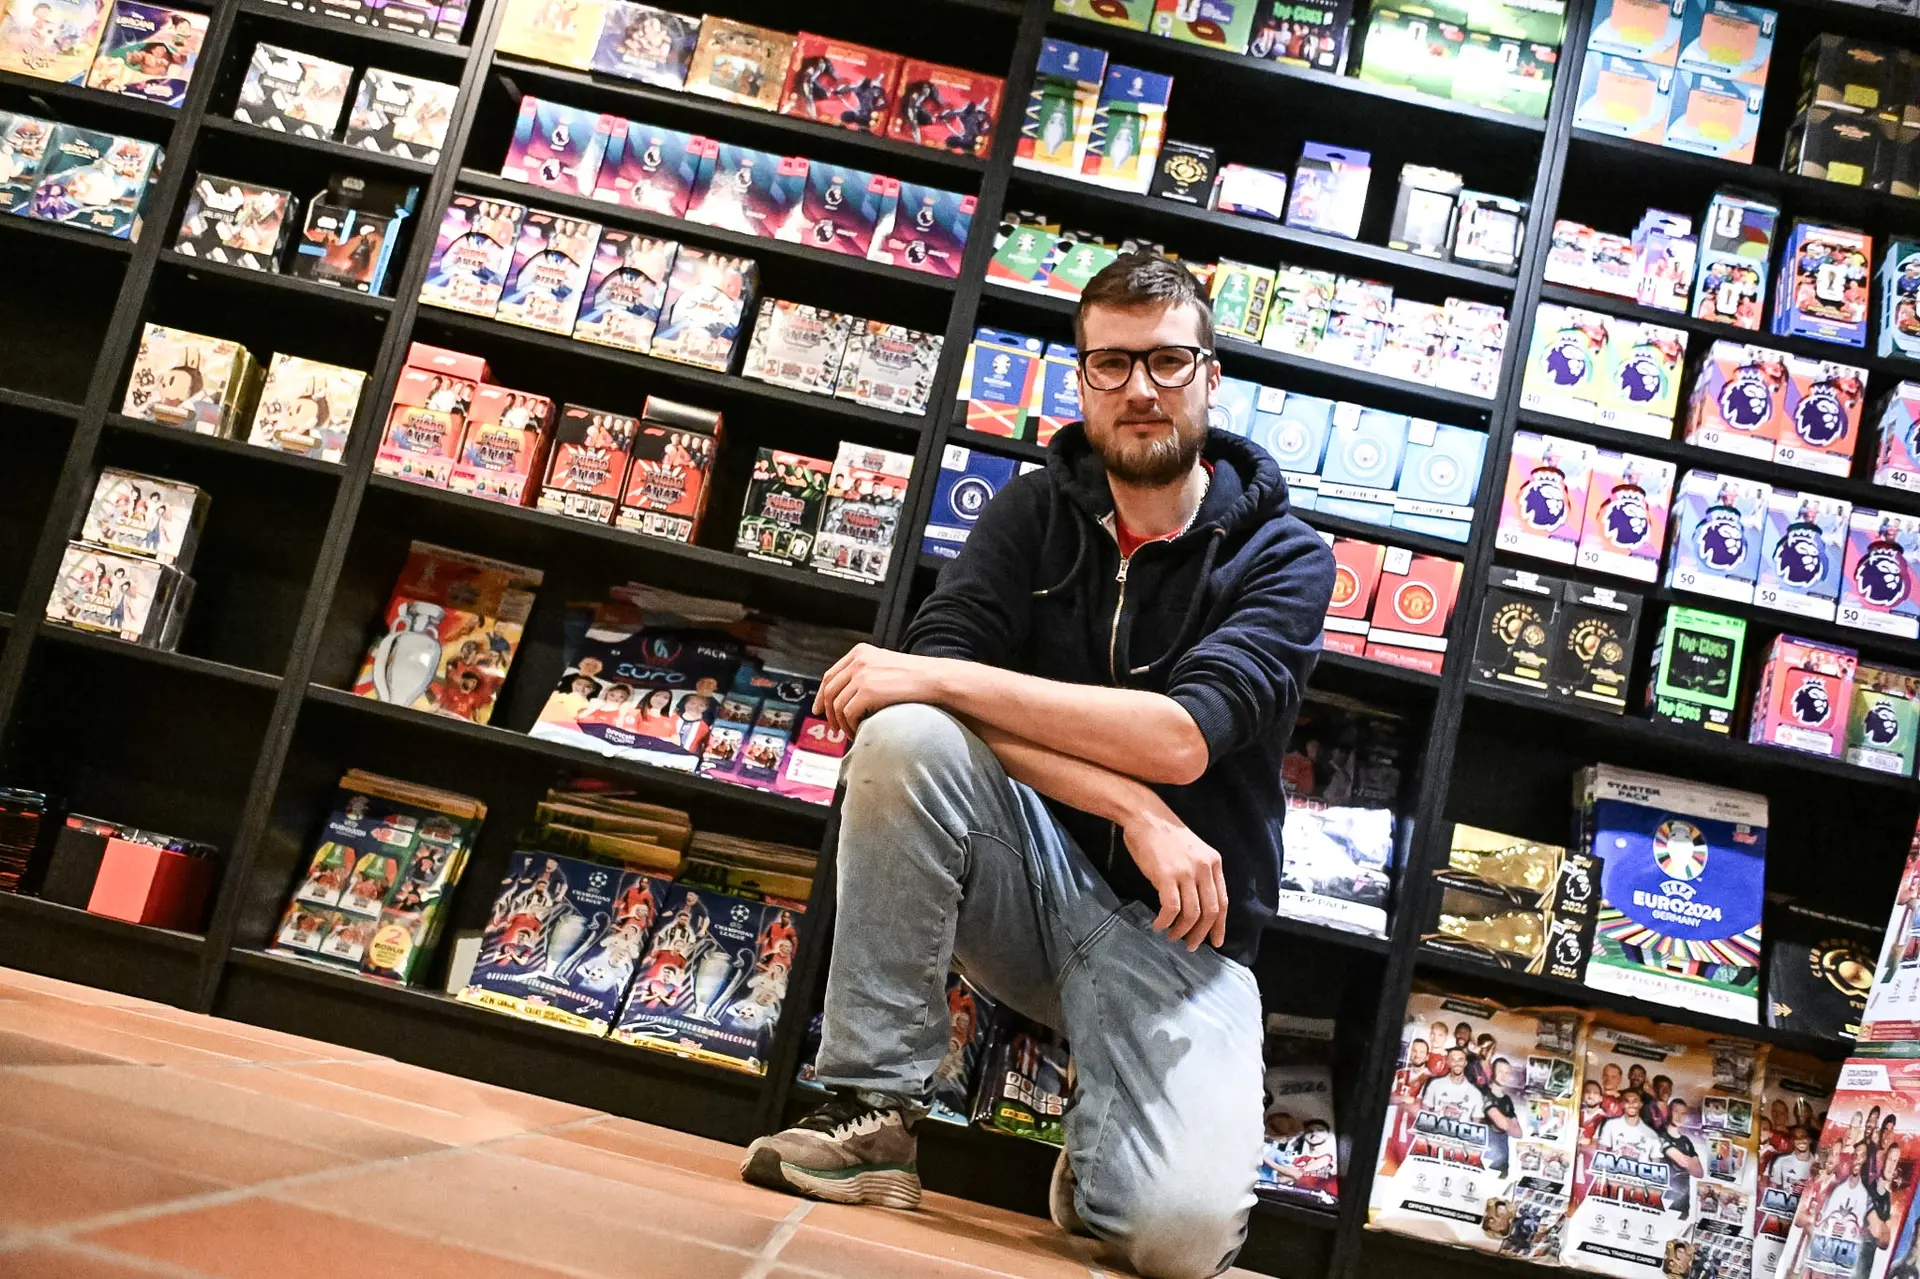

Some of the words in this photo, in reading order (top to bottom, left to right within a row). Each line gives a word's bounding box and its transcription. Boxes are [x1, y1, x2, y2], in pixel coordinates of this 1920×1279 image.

[1601, 410, 1616, 421] 40
[406, 427, 442, 445] ATTAX
[1704, 432, 1719, 443] 40
[480, 445, 516, 463] ATTAX
[1778, 448, 1795, 460] 40
[569, 464, 606, 482] ATTAX
[1891, 470, 1907, 483] 40
[642, 484, 682, 501] ATTAX
[766, 494, 805, 510] TURBO
[761, 506, 802, 524] ATTAX
[839, 524, 879, 541] ATTAX
[1503, 533, 1518, 545] 50
[1584, 552, 1599, 563] 50
[1680, 572, 1696, 585] 50
[1761, 590, 1777, 603] 50
[1491, 612, 1502, 634] CLUB
[1502, 602, 1533, 613] WORLD
[1843, 609, 1859, 621] 50
[1577, 618, 1609, 630] WORLD
[807, 723, 846, 743] 40
[1607, 781, 1661, 796] STARTER
[1617, 790, 1650, 802] PACK
[572, 889, 611, 903] CHAMPIONS
[576, 895, 602, 906] LEAGUE
[1633, 890, 1722, 922] EURO2024
[1652, 911, 1702, 928] GERMANY
[385, 928, 402, 945] 2
[714, 924, 754, 938] CHAMPIONS
[719, 931, 746, 942] LEAGUE
[1809, 948, 1823, 978] CLUB
[1616, 971, 1669, 990] OFFICIAL
[674, 1018, 708, 1035] STICKER
[1413, 1111, 1487, 1146] MATCH
[1408, 1137, 1486, 1171] ATTAX
[1592, 1151, 1669, 1186] MATCH
[1586, 1177, 1666, 1212] ATTAX
[1407, 1202, 1433, 1213] OFFICIAL
[1432, 1206, 1457, 1218] TRADING
[1592, 1197, 1620, 1207] TRADING
[1622, 1203, 1640, 1212] CARD
[1585, 1243, 1611, 1255] OFFICIAL
[1611, 1248, 1636, 1261] TRADING
[1636, 1254, 1657, 1265] CARDS
[1809, 1234, 1858, 1268] MATCH
